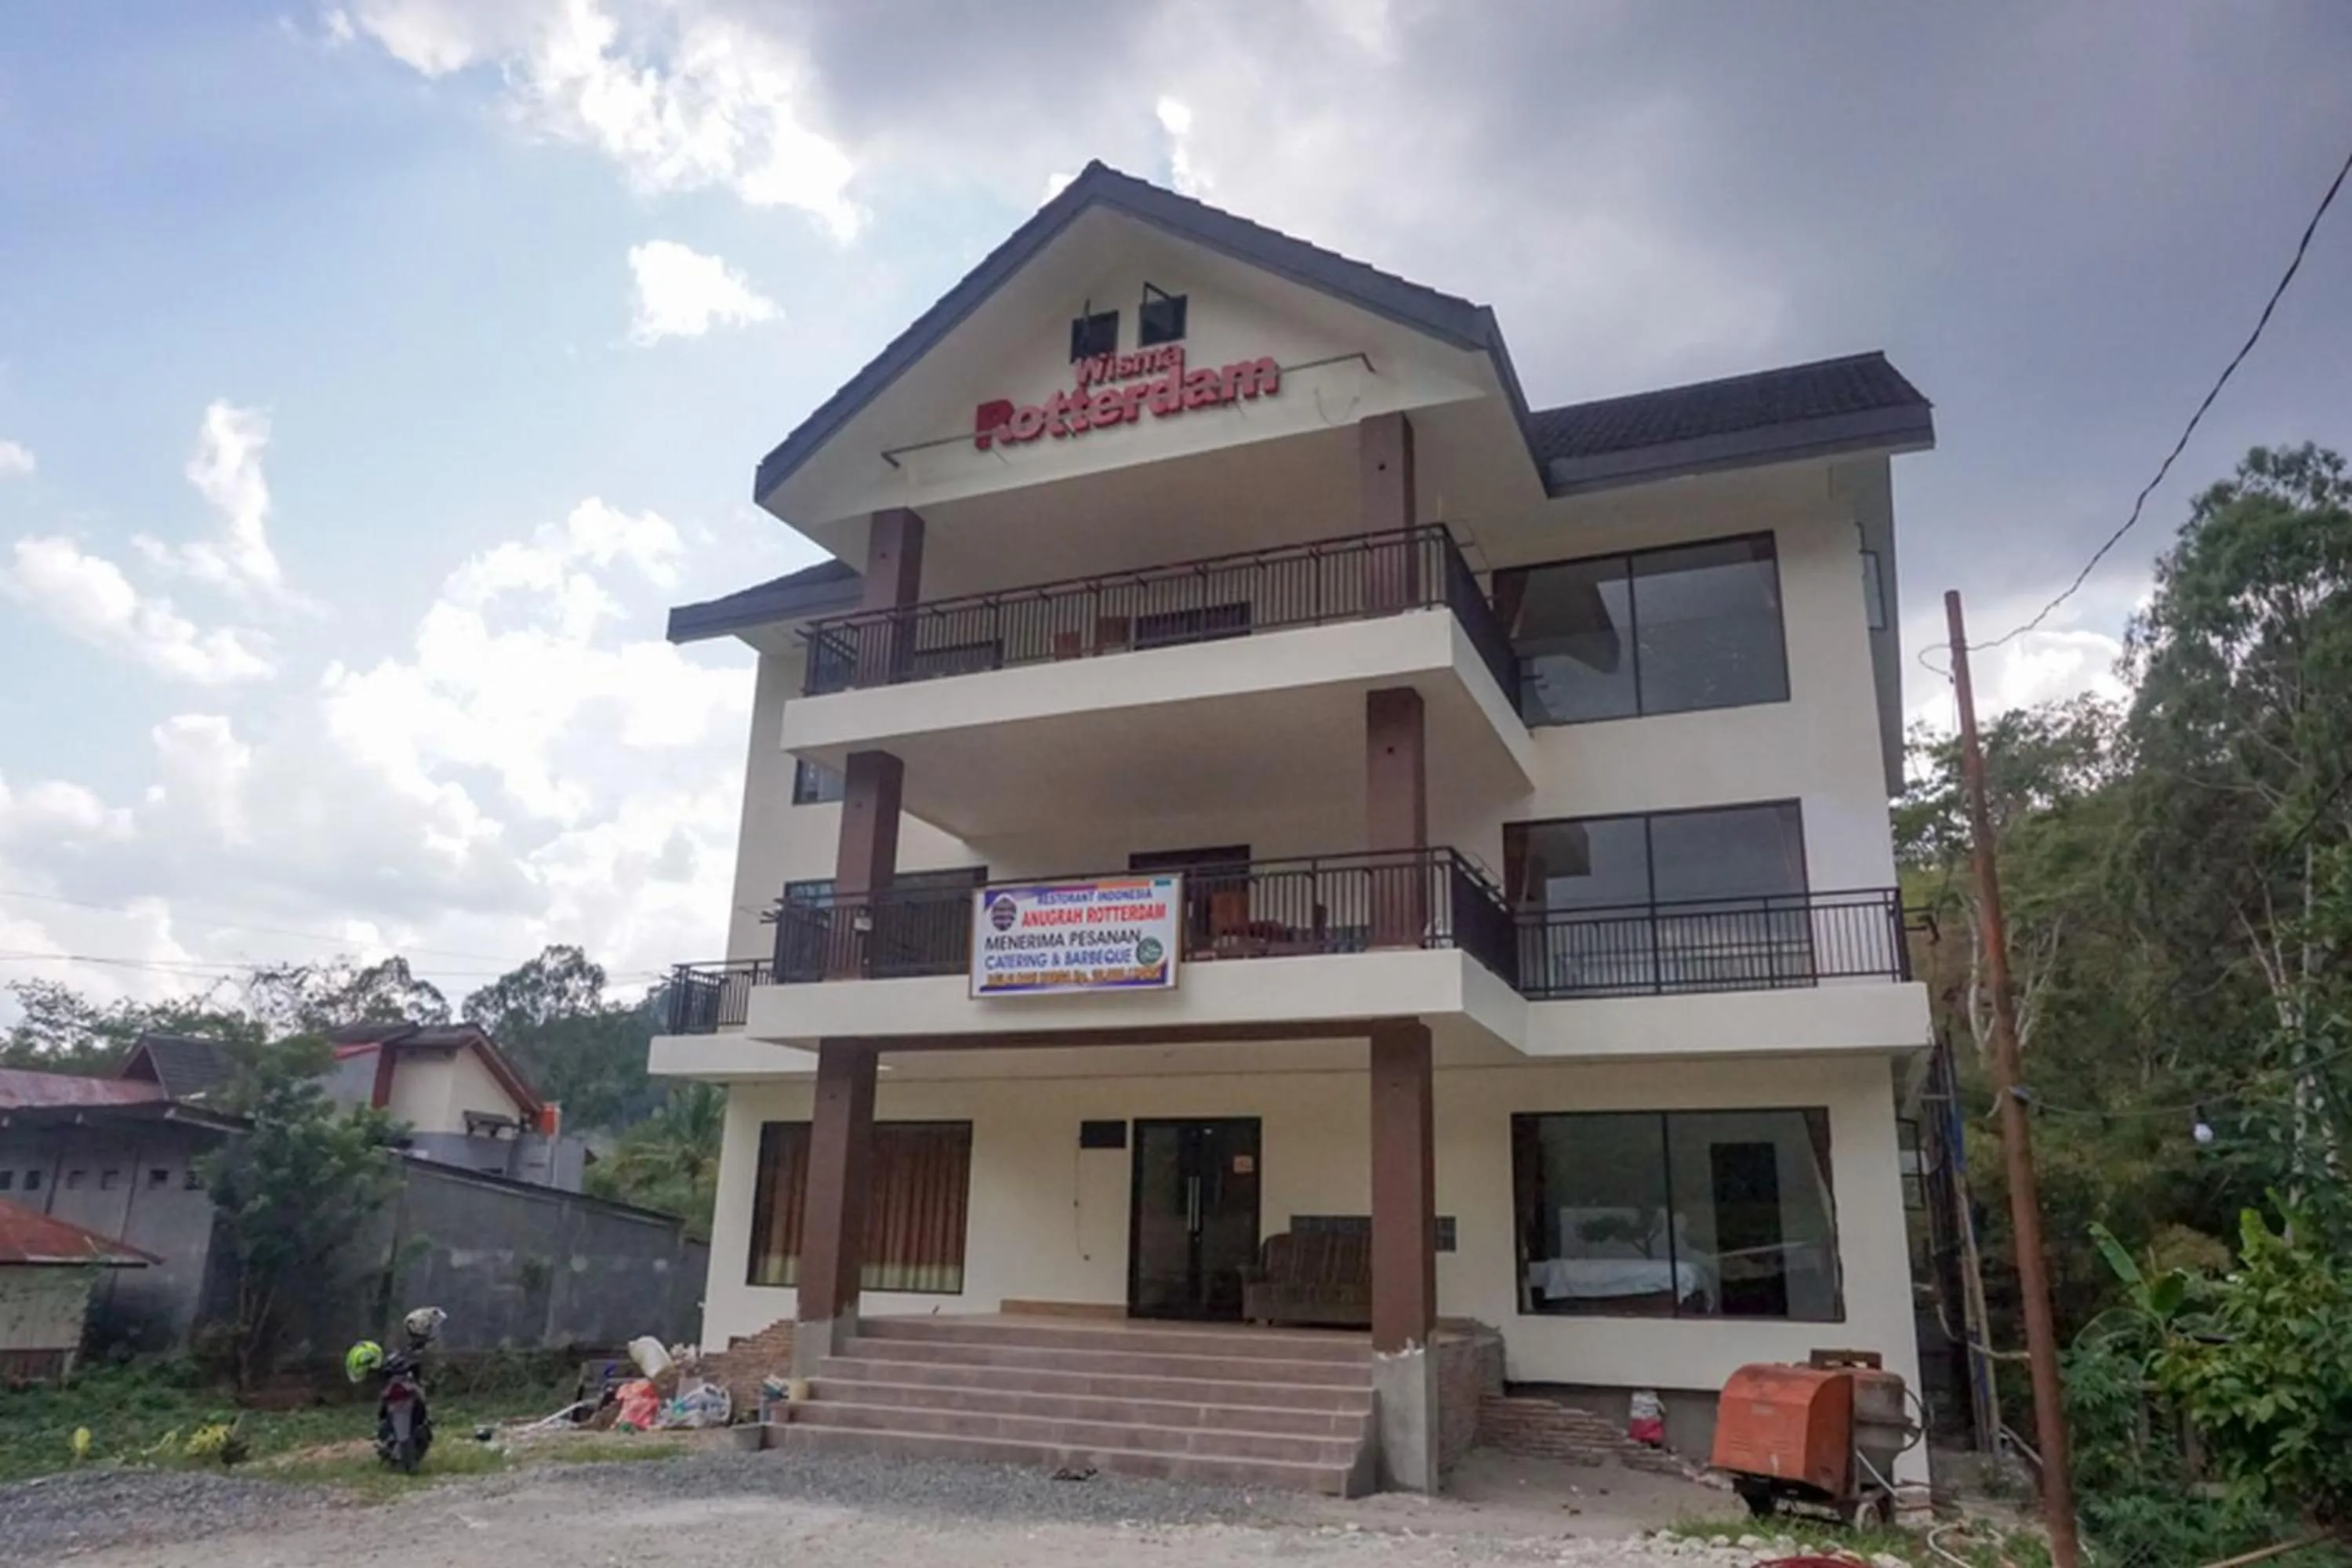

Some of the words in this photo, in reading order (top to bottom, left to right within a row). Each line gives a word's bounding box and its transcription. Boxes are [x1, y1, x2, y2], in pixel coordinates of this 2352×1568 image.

[1075, 343, 1185, 387] Wisma
[974, 354, 1280, 451] Rotterdam
[1096, 888, 1152, 901] INDONESIA
[1022, 908, 1083, 927] ANUGRAH
[1087, 903, 1167, 923] ROTTERDAM
[984, 933, 1065, 951] MENERIMA
[1069, 928, 1142, 947] PESANAN
[984, 953, 1047, 971] CATERING
[1064, 948, 1132, 966] BARBEQUE
